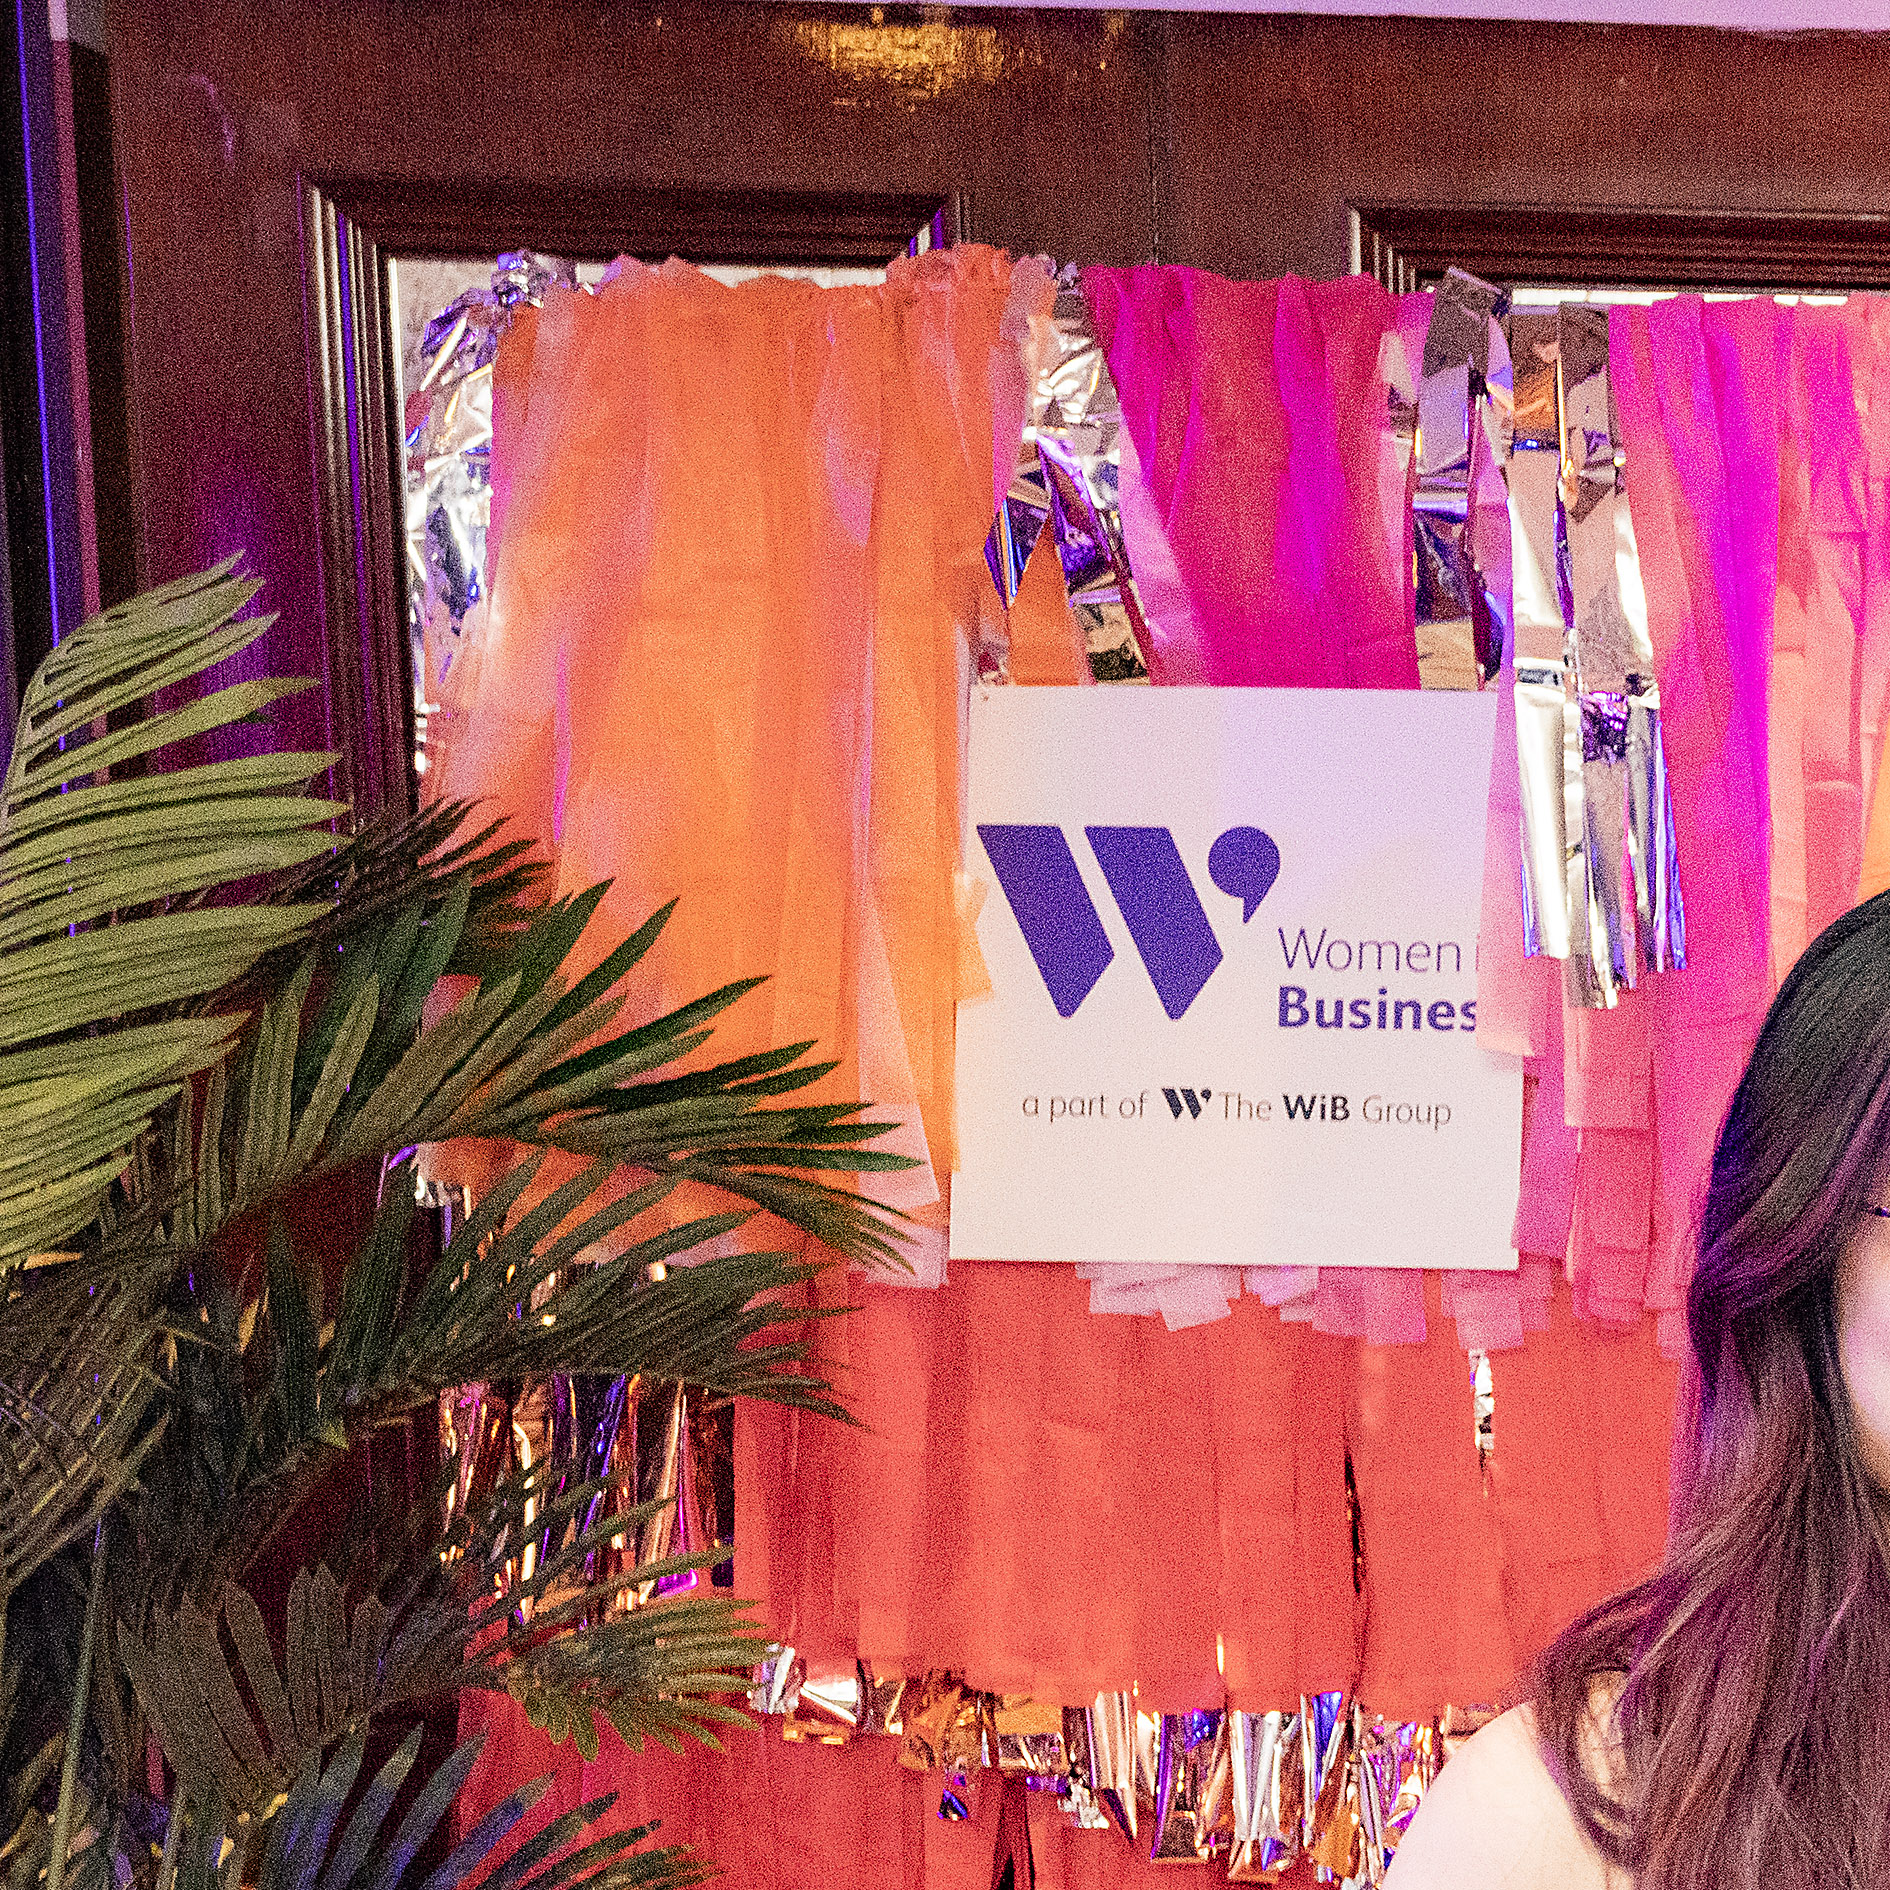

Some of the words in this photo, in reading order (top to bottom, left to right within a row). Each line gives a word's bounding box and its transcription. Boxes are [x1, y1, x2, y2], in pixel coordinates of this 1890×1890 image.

[1278, 926, 1461, 973] Women
[1022, 1095, 1039, 1118] a
[1050, 1094, 1110, 1123] part
[1119, 1089, 1149, 1119] of
[1219, 1092, 1272, 1122] The
[1282, 1093, 1351, 1122] WiB
[1362, 1094, 1452, 1132] Group
